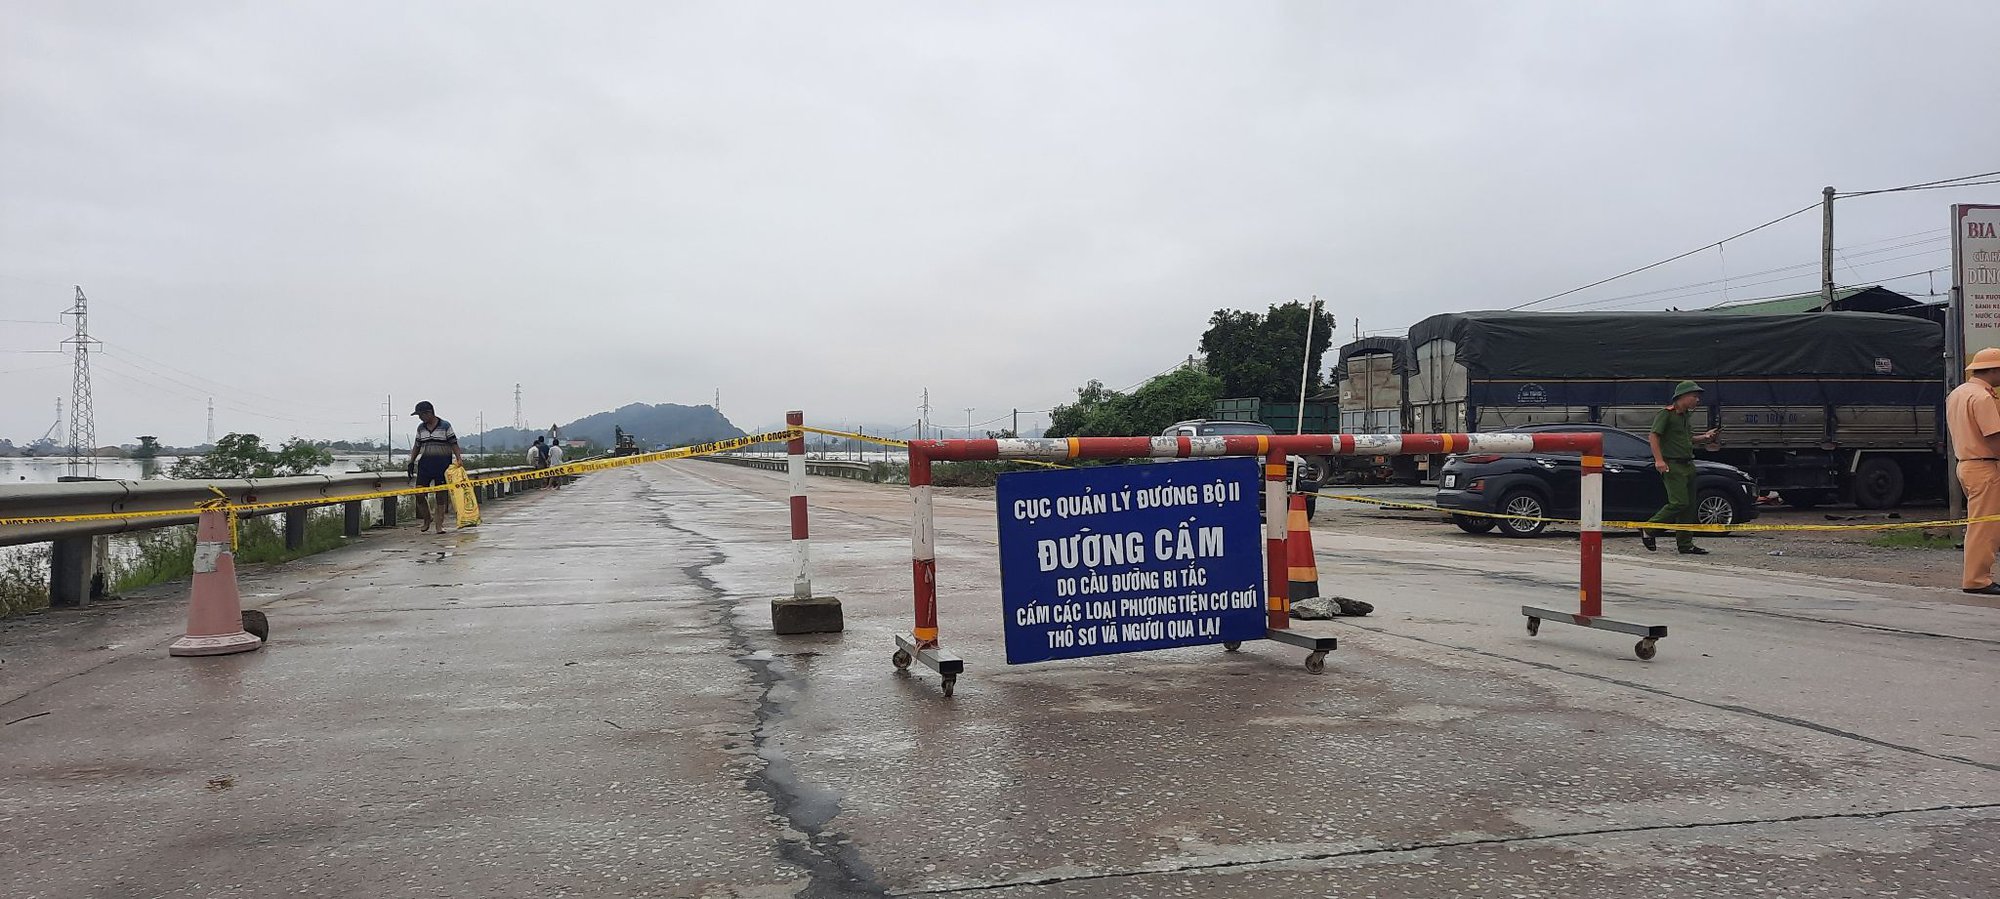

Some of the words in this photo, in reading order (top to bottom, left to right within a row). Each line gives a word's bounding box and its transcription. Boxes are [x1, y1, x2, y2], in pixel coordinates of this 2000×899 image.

[1968, 222, 1997, 239] BIA
[690, 443, 717, 455] POLICE
[719, 440, 736, 450] LINE
[738, 437, 748, 446] DO
[751, 434, 765, 443] NOT
[767, 430, 792, 441] CROSS
[1014, 498, 1051, 524] CỤC
[1056, 486, 1107, 519] QUẢN
[1111, 484, 1131, 512] LÝ
[1203, 478, 1226, 507] BỘ
[1228, 482, 1240, 501] II
[1155, 516, 1224, 560] CẤM
[1057, 577, 1076, 597] DO
[1080, 569, 1109, 594] CẦU
[1181, 561, 1207, 587] TẮC
[1016, 600, 1050, 627] CẤM
[1053, 599, 1081, 623] CÁC
[1085, 600, 1117, 622] LOẠI
[1120, 596, 1177, 617] PHƯƠNG
[1178, 590, 1208, 615] TIỆN
[1210, 590, 1229, 611] CƠ
[1231, 584, 1257, 609] GIỚI
[1047, 625, 1074, 649] THÔ
[1078, 626, 1097, 646] SƠ
[1167, 619, 1195, 640] QUA
[1199, 617, 1221, 639] LẠI
